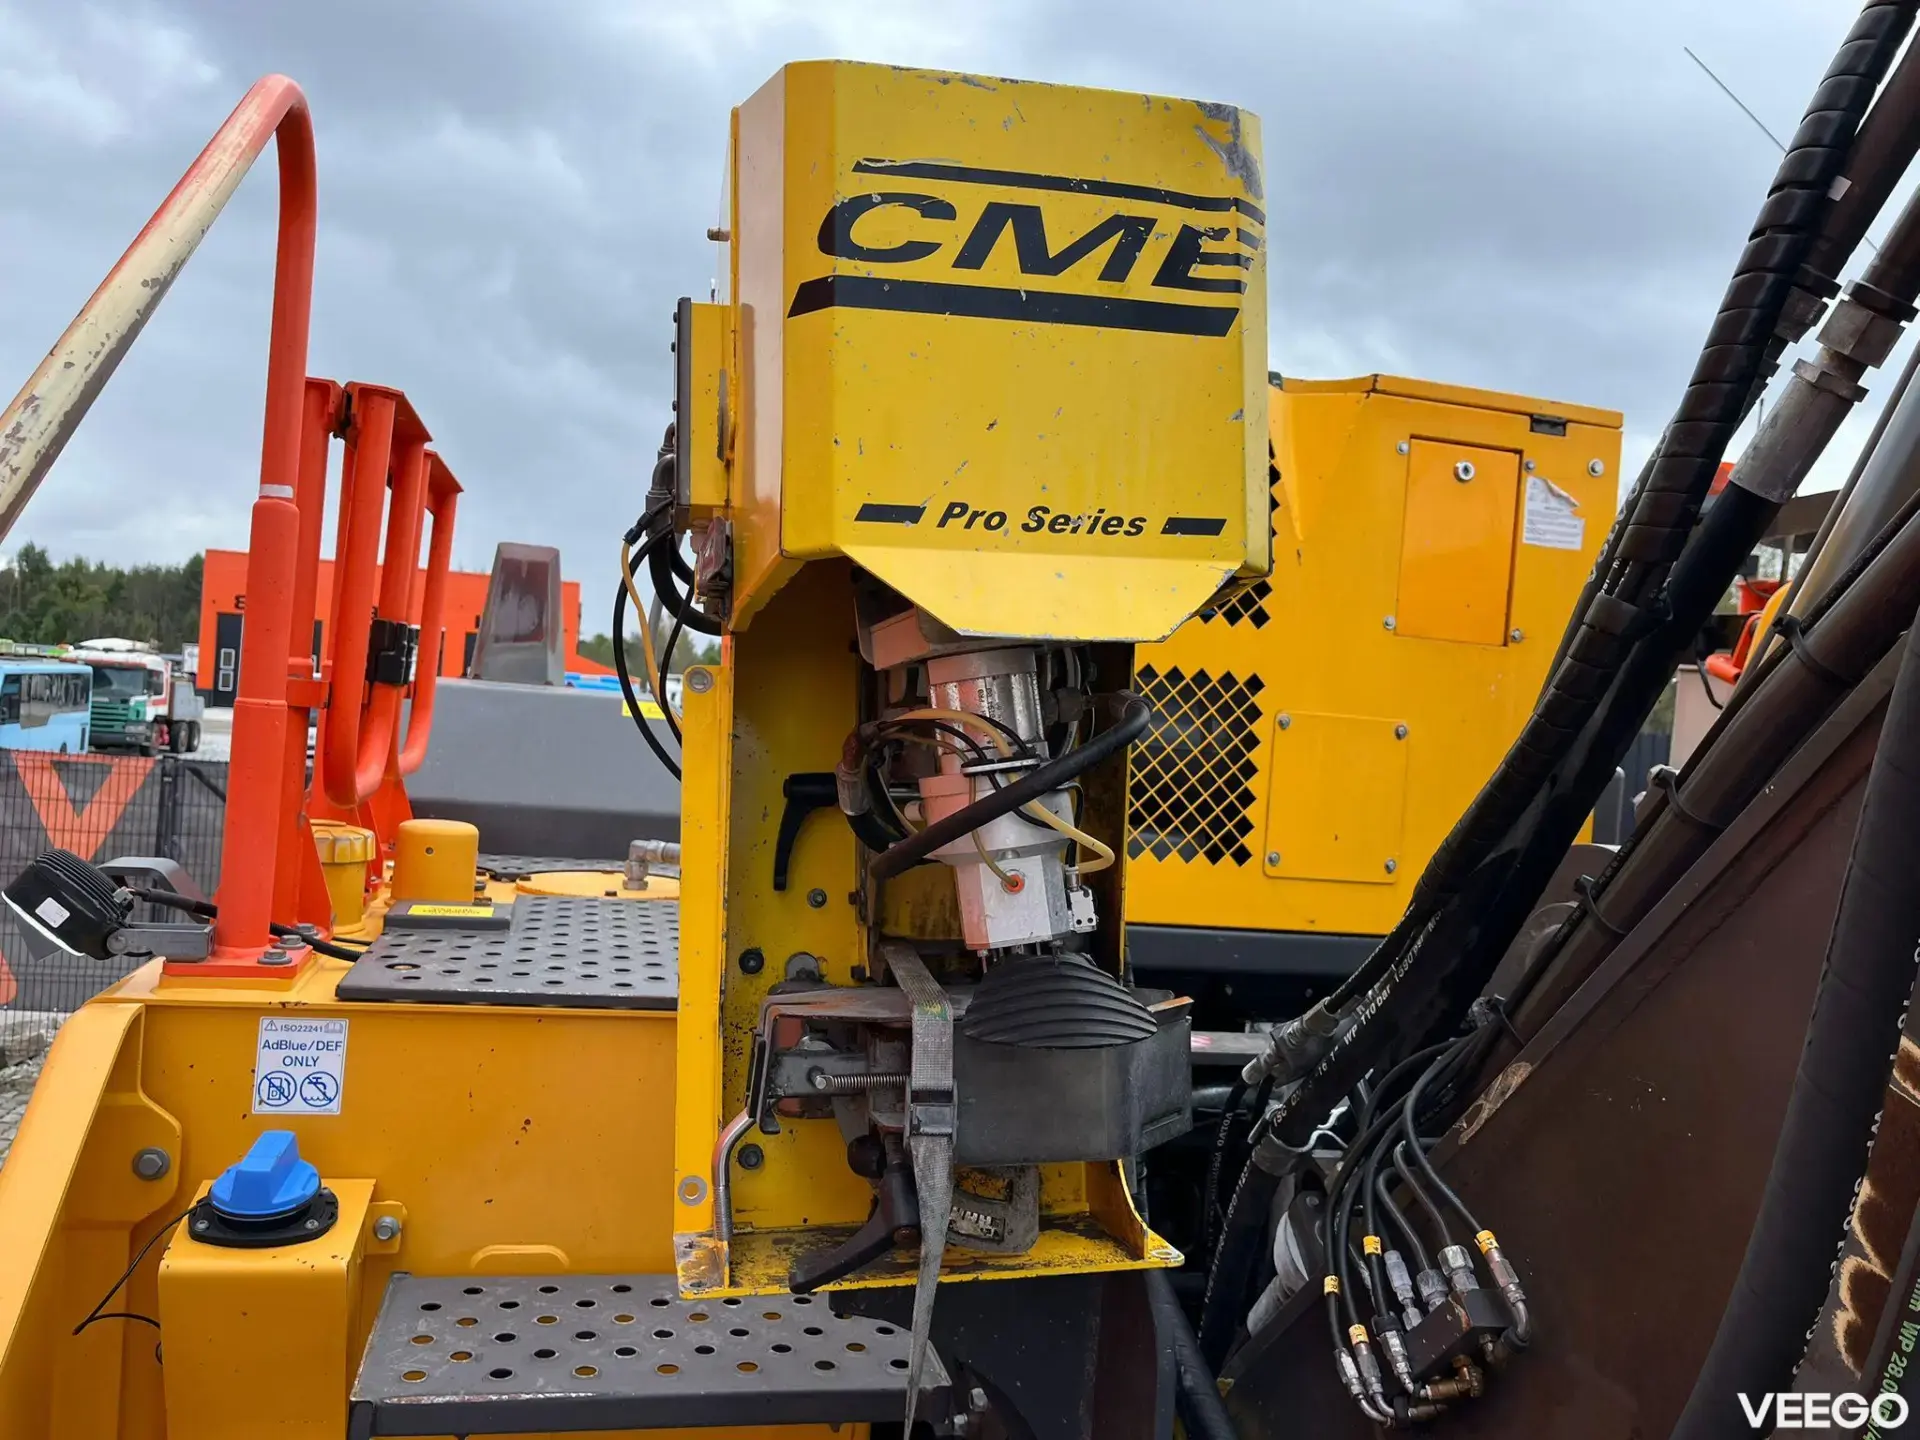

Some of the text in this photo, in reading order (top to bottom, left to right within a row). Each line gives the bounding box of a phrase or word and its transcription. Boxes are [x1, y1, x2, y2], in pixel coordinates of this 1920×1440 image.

[817, 192, 1264, 295] CME
[936, 501, 1147, 538] Pro Series
[280, 1024, 323, 1033] ISO22241
[262, 1039, 343, 1052] AdBlue/DEF
[282, 1055, 320, 1068] ONLY
[1898, 1320, 1920, 1352] WP
